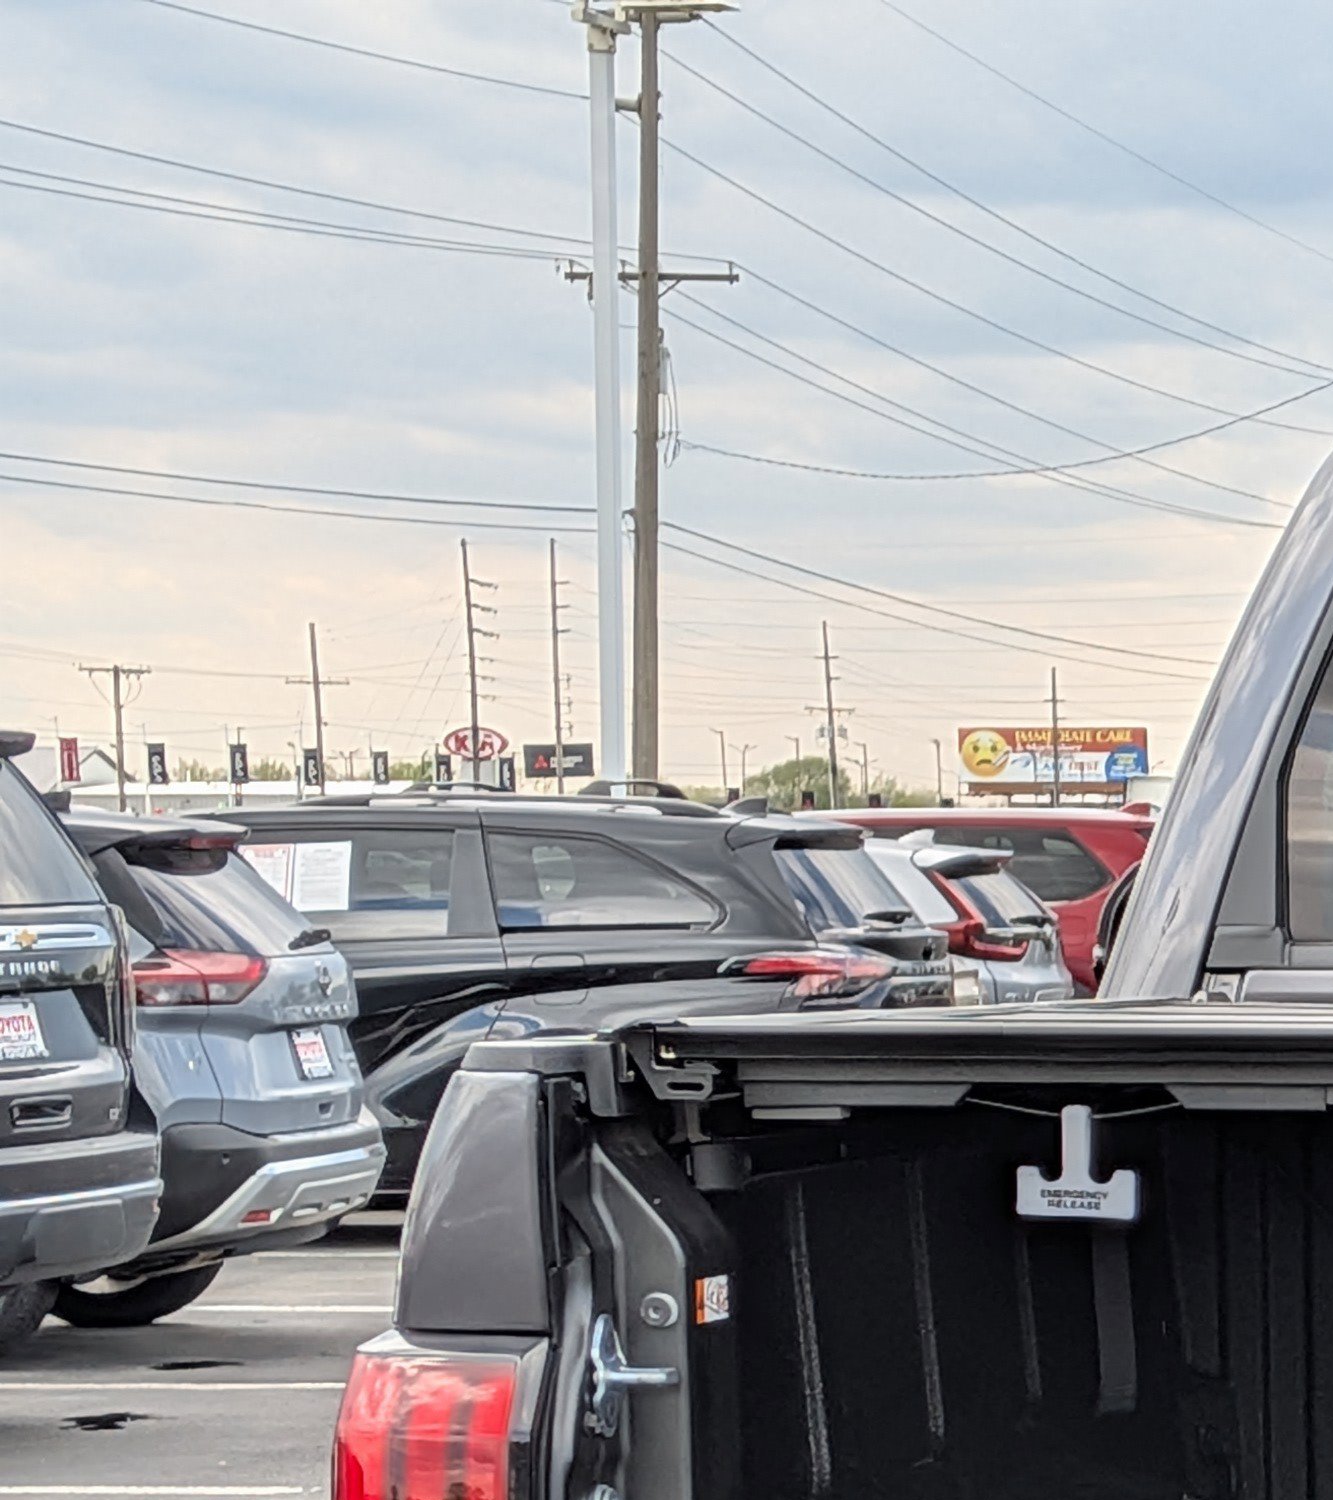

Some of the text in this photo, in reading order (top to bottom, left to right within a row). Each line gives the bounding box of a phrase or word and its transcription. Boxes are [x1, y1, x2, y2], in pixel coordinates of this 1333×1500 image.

[454, 734, 494, 752] KA
[1040, 1189, 1109, 1199] EMERGENCY
[1047, 1199, 1101, 1210] RELEASE
